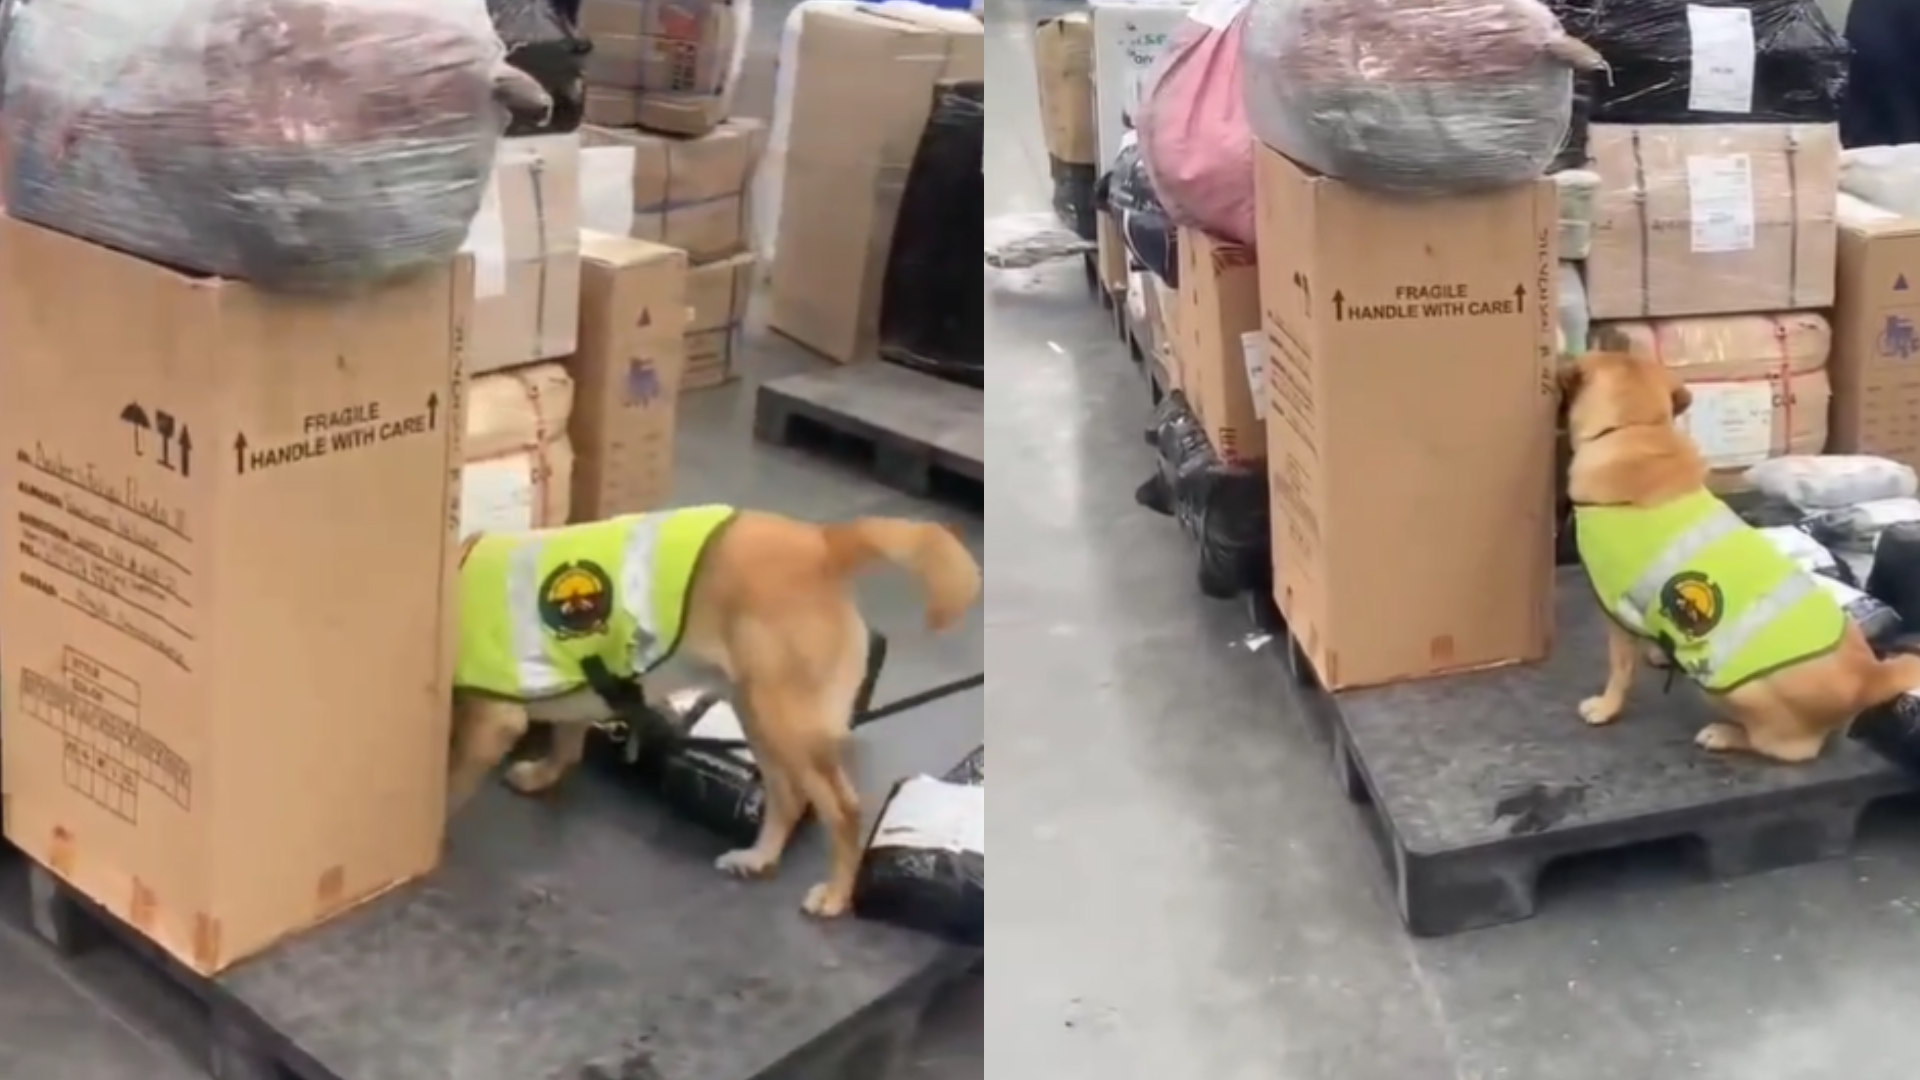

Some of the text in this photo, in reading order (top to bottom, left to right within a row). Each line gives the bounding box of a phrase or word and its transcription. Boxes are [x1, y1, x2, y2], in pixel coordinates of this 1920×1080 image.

[1395, 284, 1468, 300] FRAGILE
[1348, 300, 1513, 320] HANDLE WITH CARE
[304, 401, 380, 434] FRAGILE
[250, 414, 426, 471] HANDLE WITH CARE
